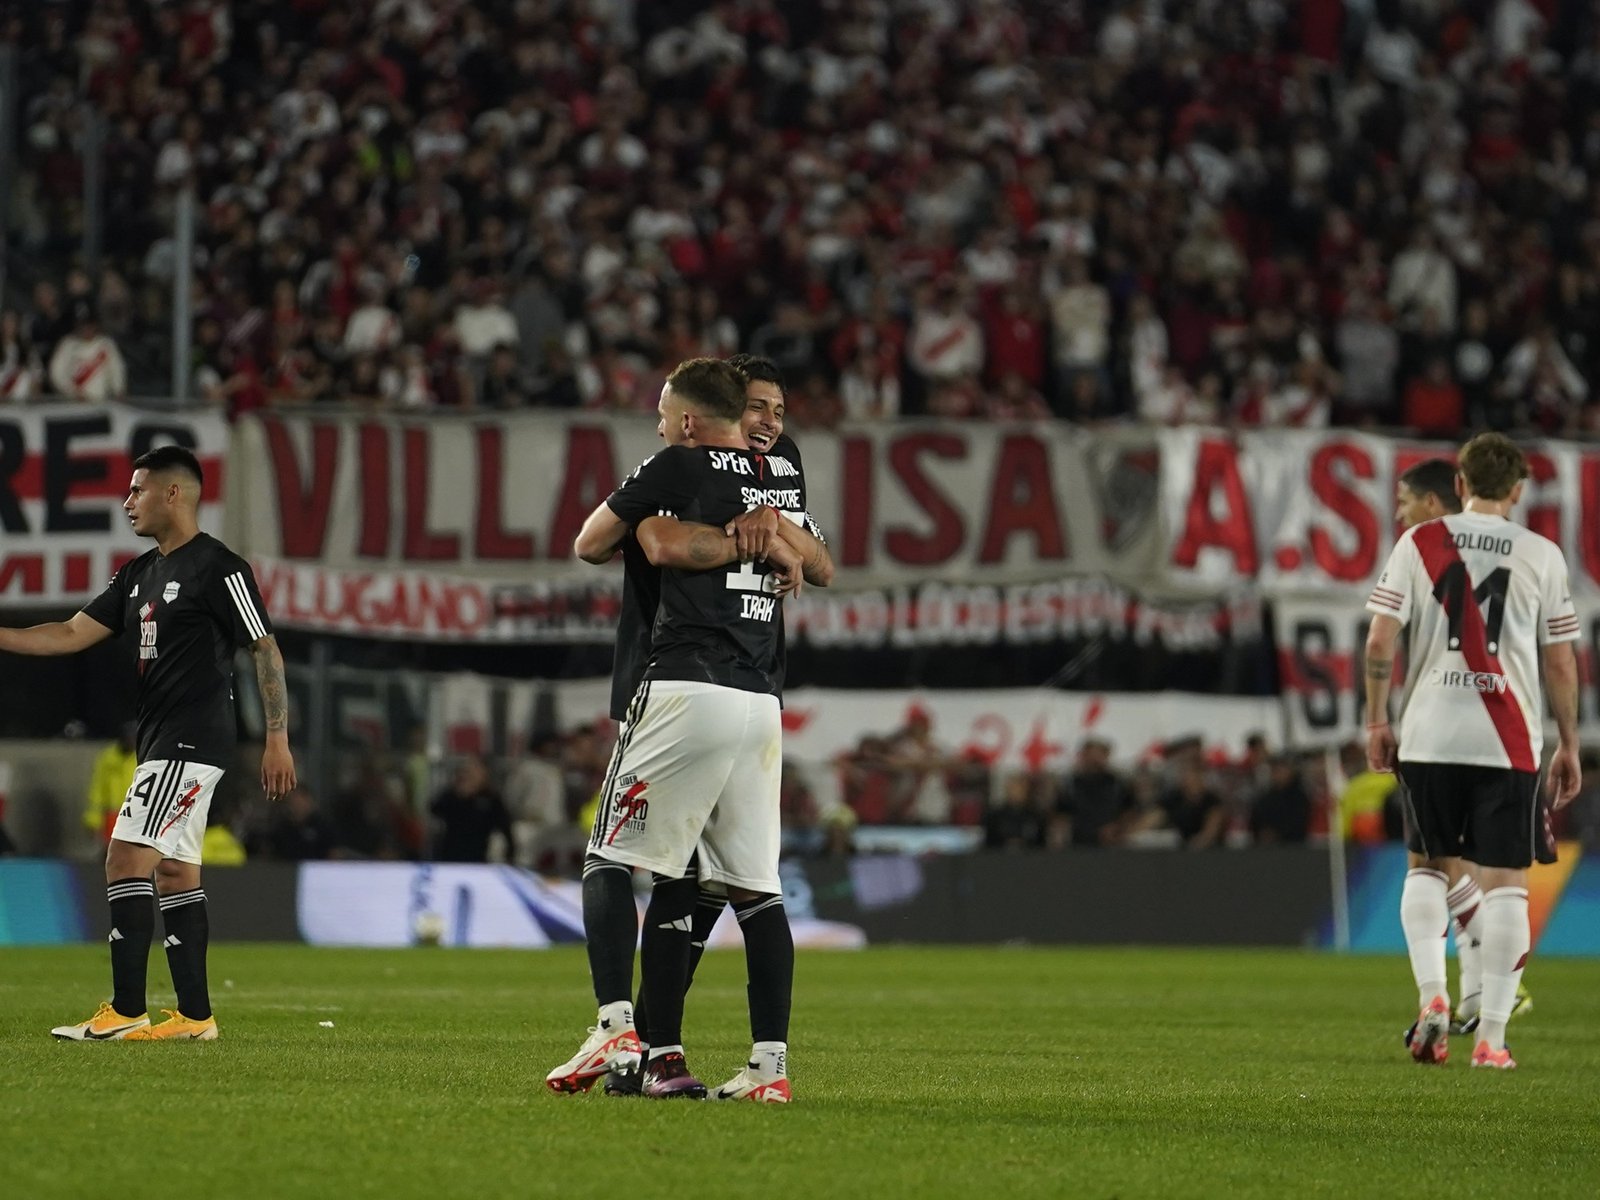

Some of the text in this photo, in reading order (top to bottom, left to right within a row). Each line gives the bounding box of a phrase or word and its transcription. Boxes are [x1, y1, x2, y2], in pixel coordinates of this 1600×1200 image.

[263, 414, 622, 560] VILLA
[1443, 532, 1513, 556] COLIDIO
[1433, 560, 1511, 656] 11
[1431, 669, 1510, 695] DIRECTV
